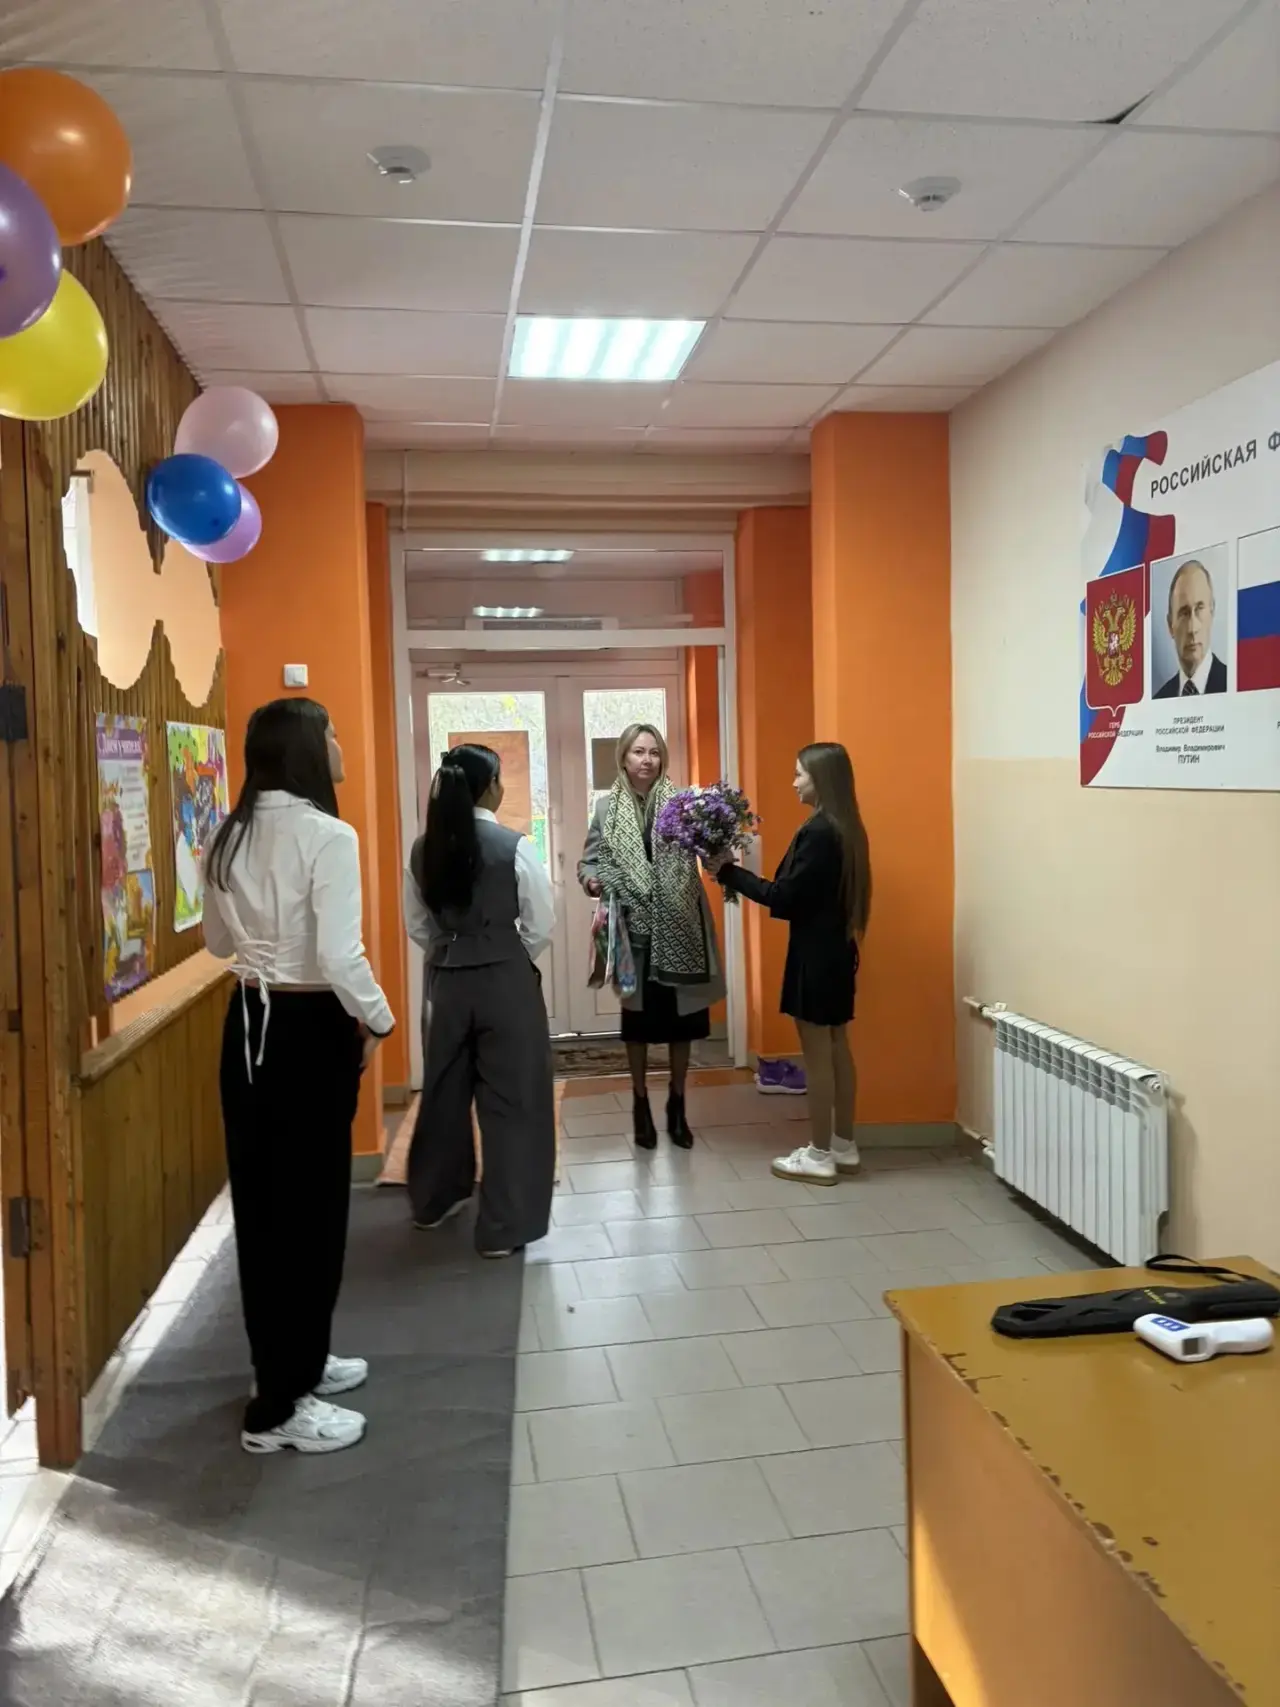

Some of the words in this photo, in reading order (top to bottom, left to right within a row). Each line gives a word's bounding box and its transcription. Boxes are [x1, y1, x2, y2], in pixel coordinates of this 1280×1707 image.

[1151, 439, 1257, 498] РОССИЙСКАЯ
[1173, 716, 1204, 724] ПРЕЗИДЕНТ
[1155, 726, 1189, 735] РОССИЙСКОЙ
[1191, 725, 1225, 733] ФЕДЕРАЦИИ
[1156, 745, 1182, 753] Владимир
[1183, 744, 1226, 752] Владимирович
[1178, 754, 1200, 764] ПУТИН
